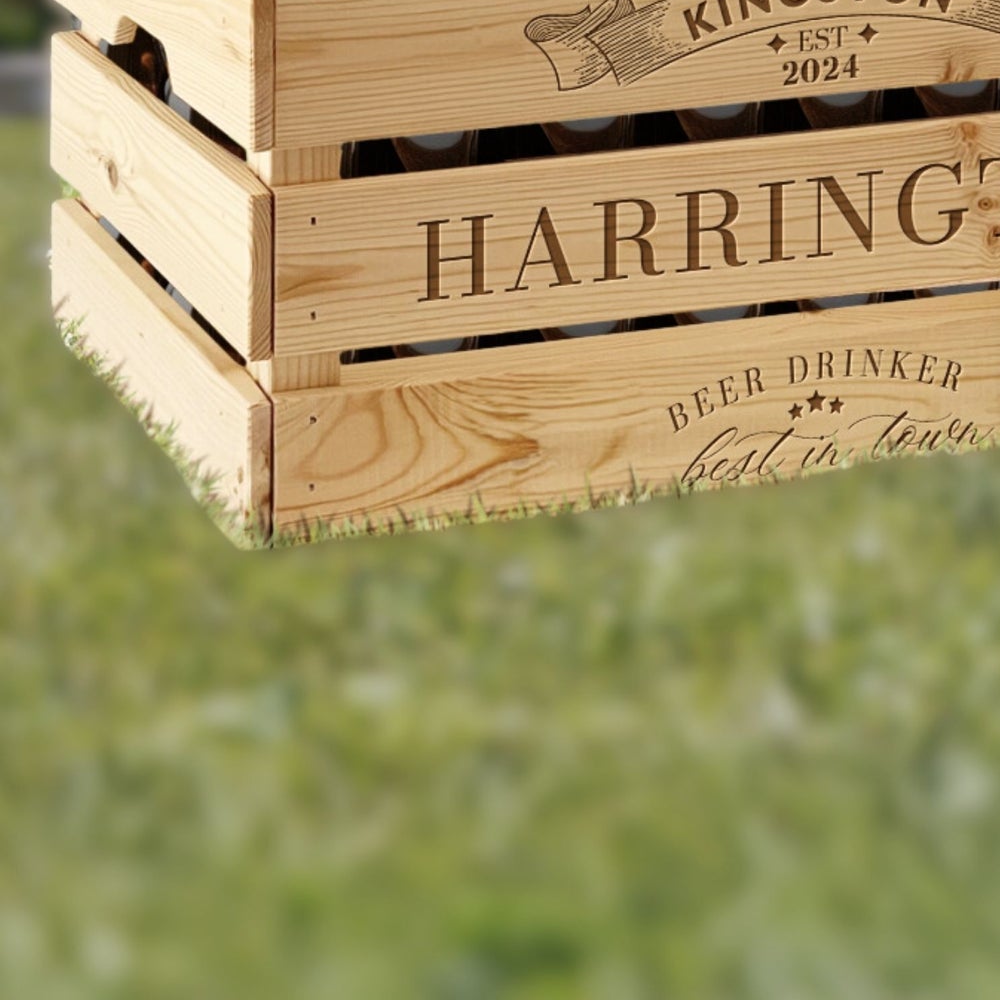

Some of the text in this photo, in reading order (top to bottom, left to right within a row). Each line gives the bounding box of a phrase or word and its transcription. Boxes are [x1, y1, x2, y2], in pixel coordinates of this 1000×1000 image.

[799, 26, 848, 52] EST
[782, 54, 860, 86] 2024
[666, 349, 963, 433] BEER DRINKER
[681, 411, 995, 487] best in town
